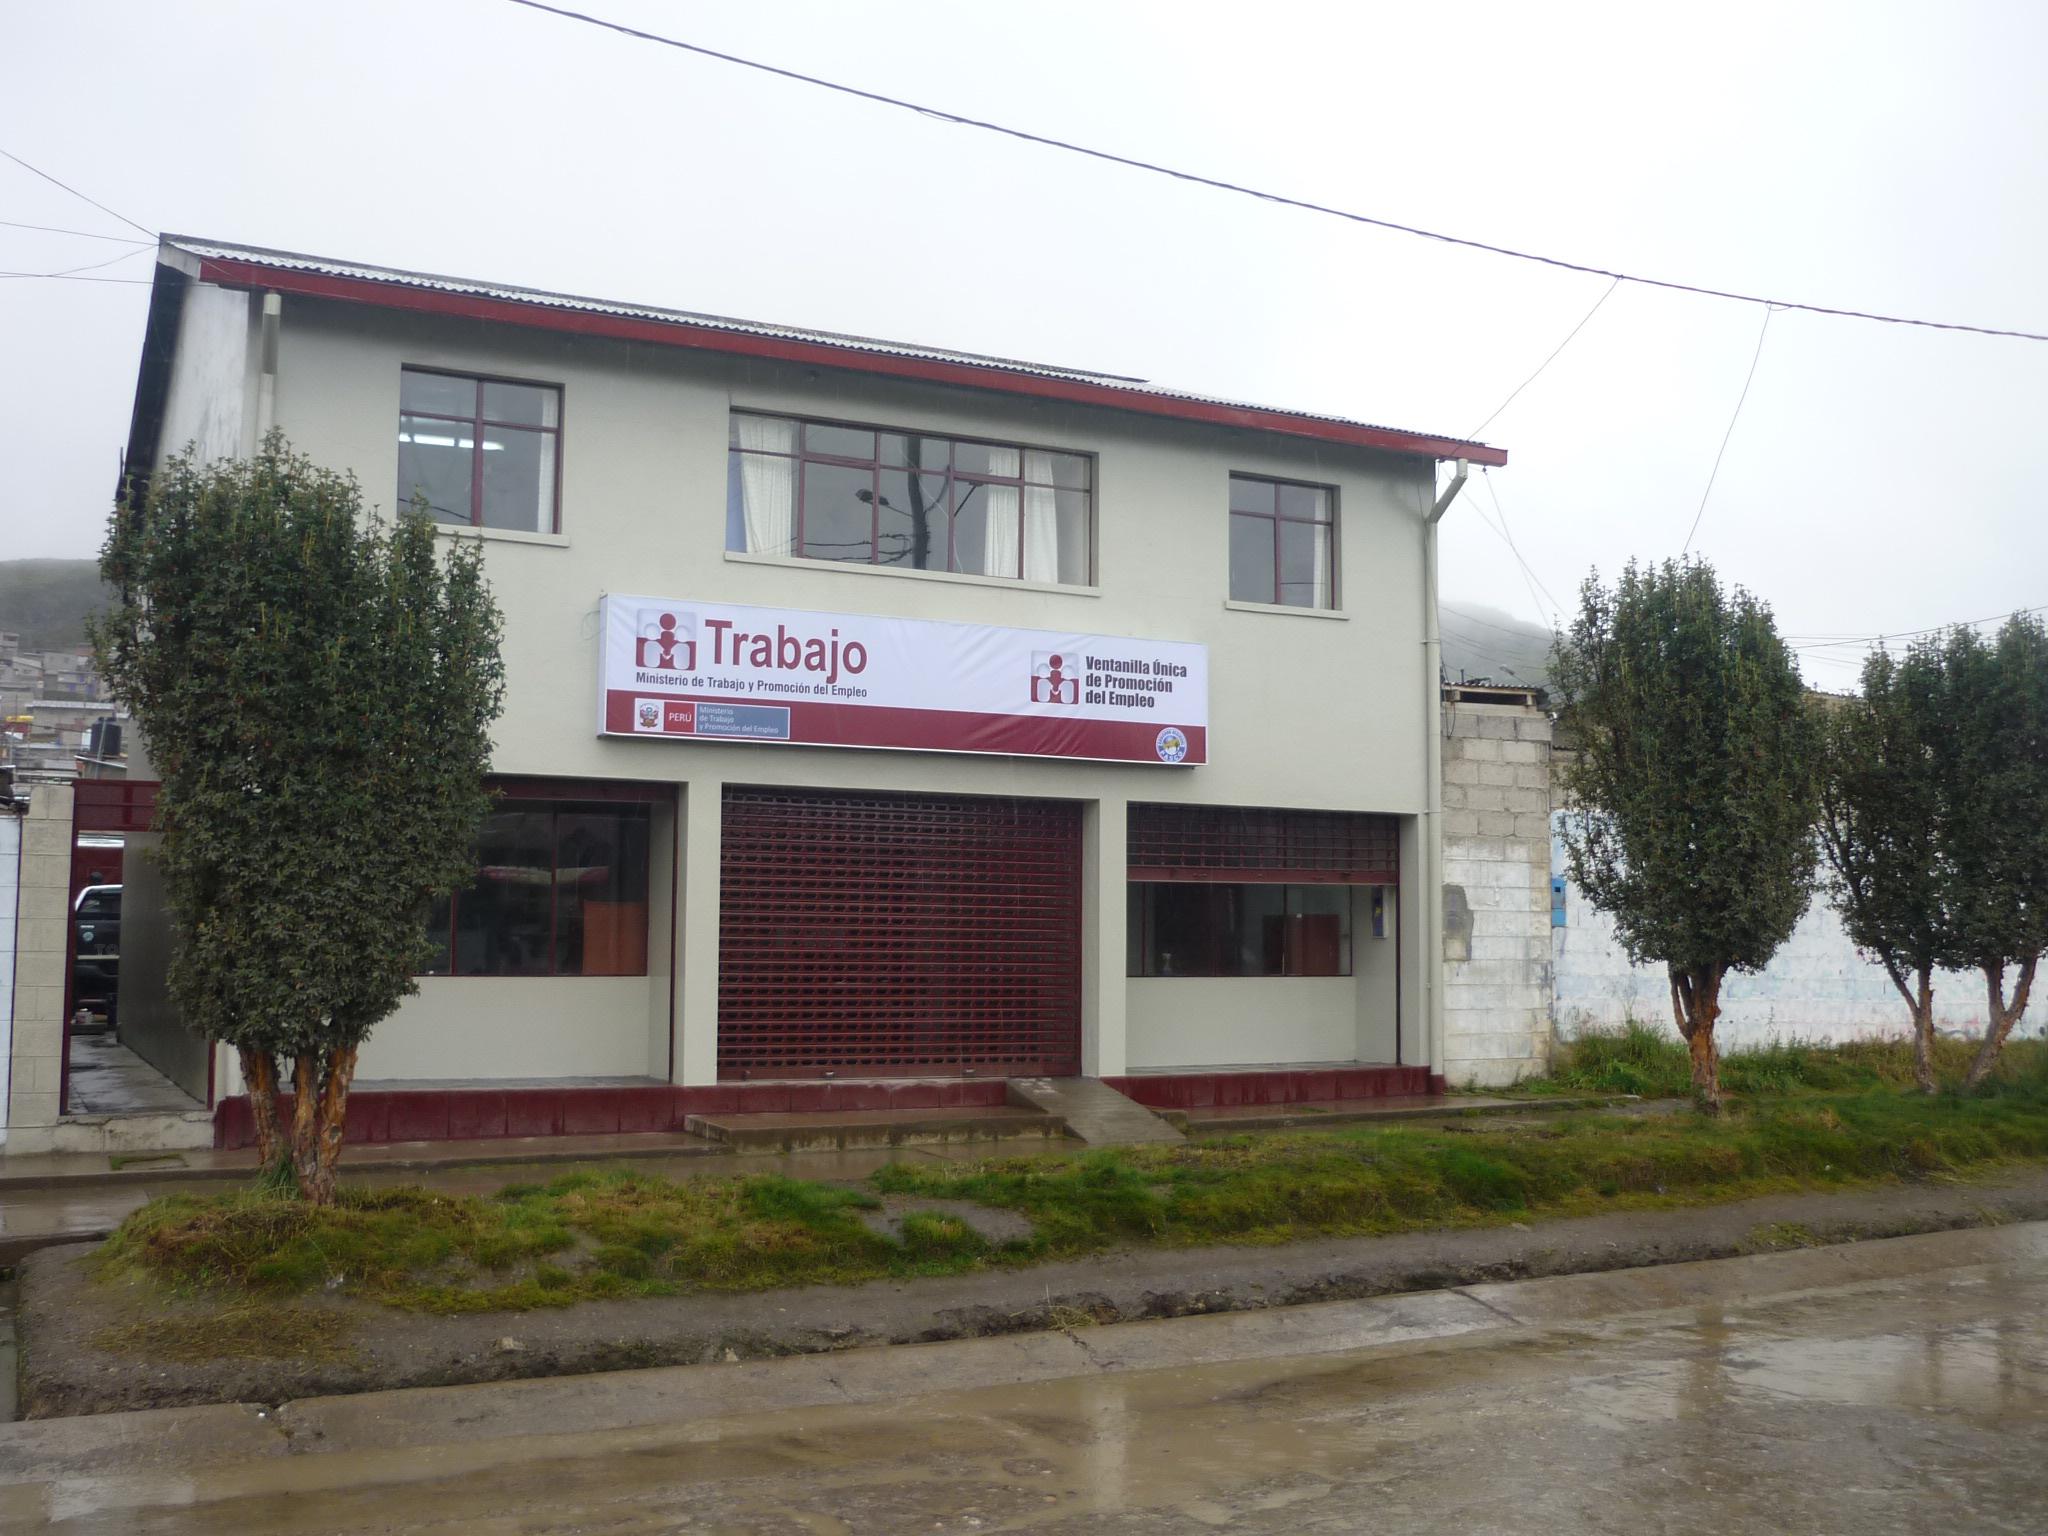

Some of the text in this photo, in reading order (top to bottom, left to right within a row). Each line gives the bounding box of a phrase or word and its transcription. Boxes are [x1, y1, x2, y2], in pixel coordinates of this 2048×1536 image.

[705, 619, 867, 684] Trabajo
[1085, 656, 1187, 677] Ventanilla Única
[636, 672, 867, 698] Ministerio de Trabajo y Promoción del Empleo
[1085, 673, 1173, 693] de Promoción
[1085, 690, 1155, 708] del Empleo
[669, 712, 692, 722] PERÚ
[699, 706, 734, 715] Ministerio
[710, 715, 735, 723] Trabajo
[704, 723, 741, 733] Promoción
[754, 726, 779, 735] Empleo
